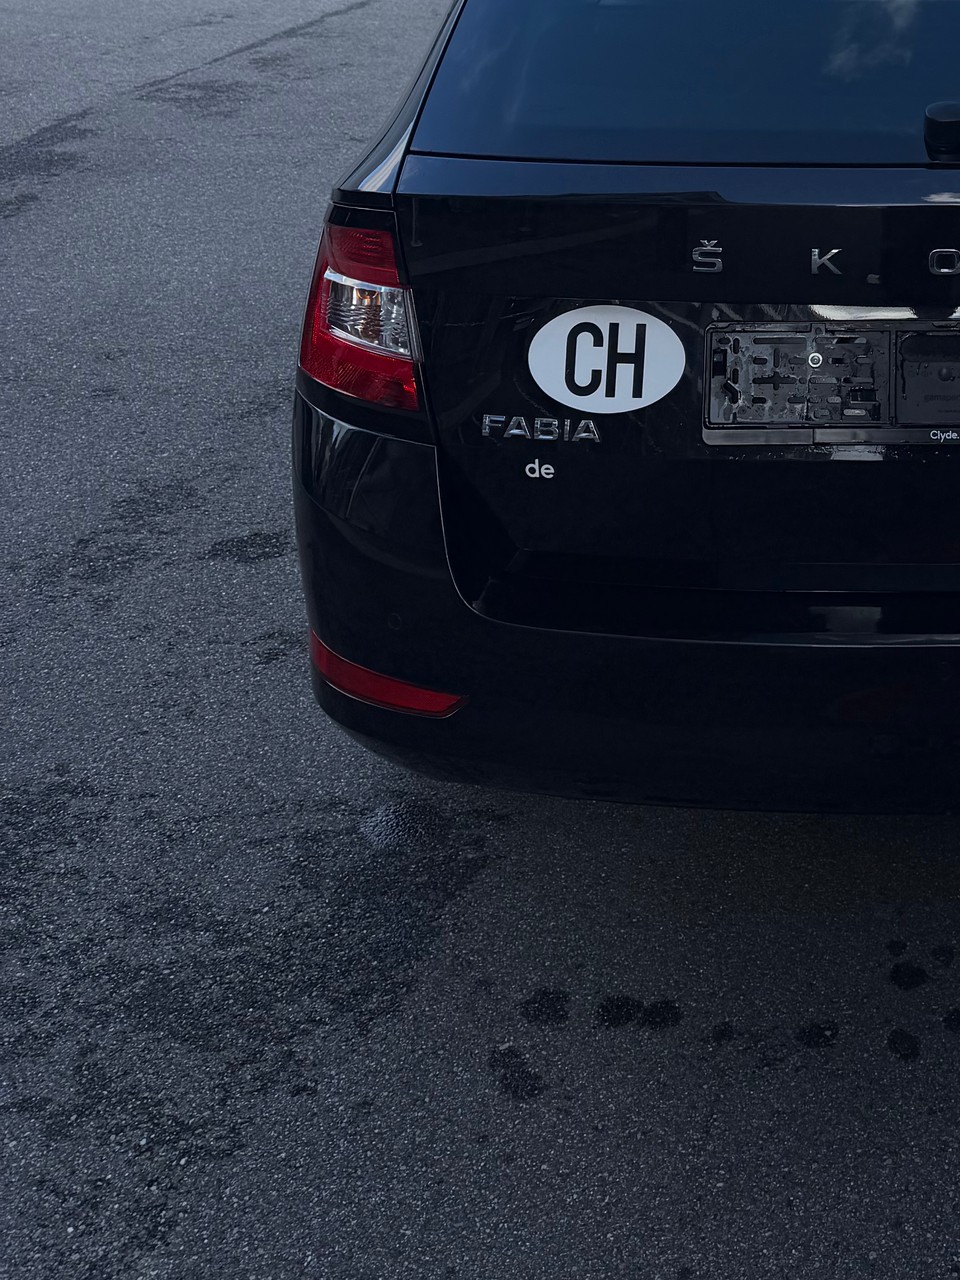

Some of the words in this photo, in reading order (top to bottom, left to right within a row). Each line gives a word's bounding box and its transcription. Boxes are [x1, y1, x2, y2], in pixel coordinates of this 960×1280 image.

[564, 321, 647, 399] CH
[482, 414, 601, 443] FABIA
[929, 430, 960, 443] Clyde.
[525, 458, 555, 479] de
